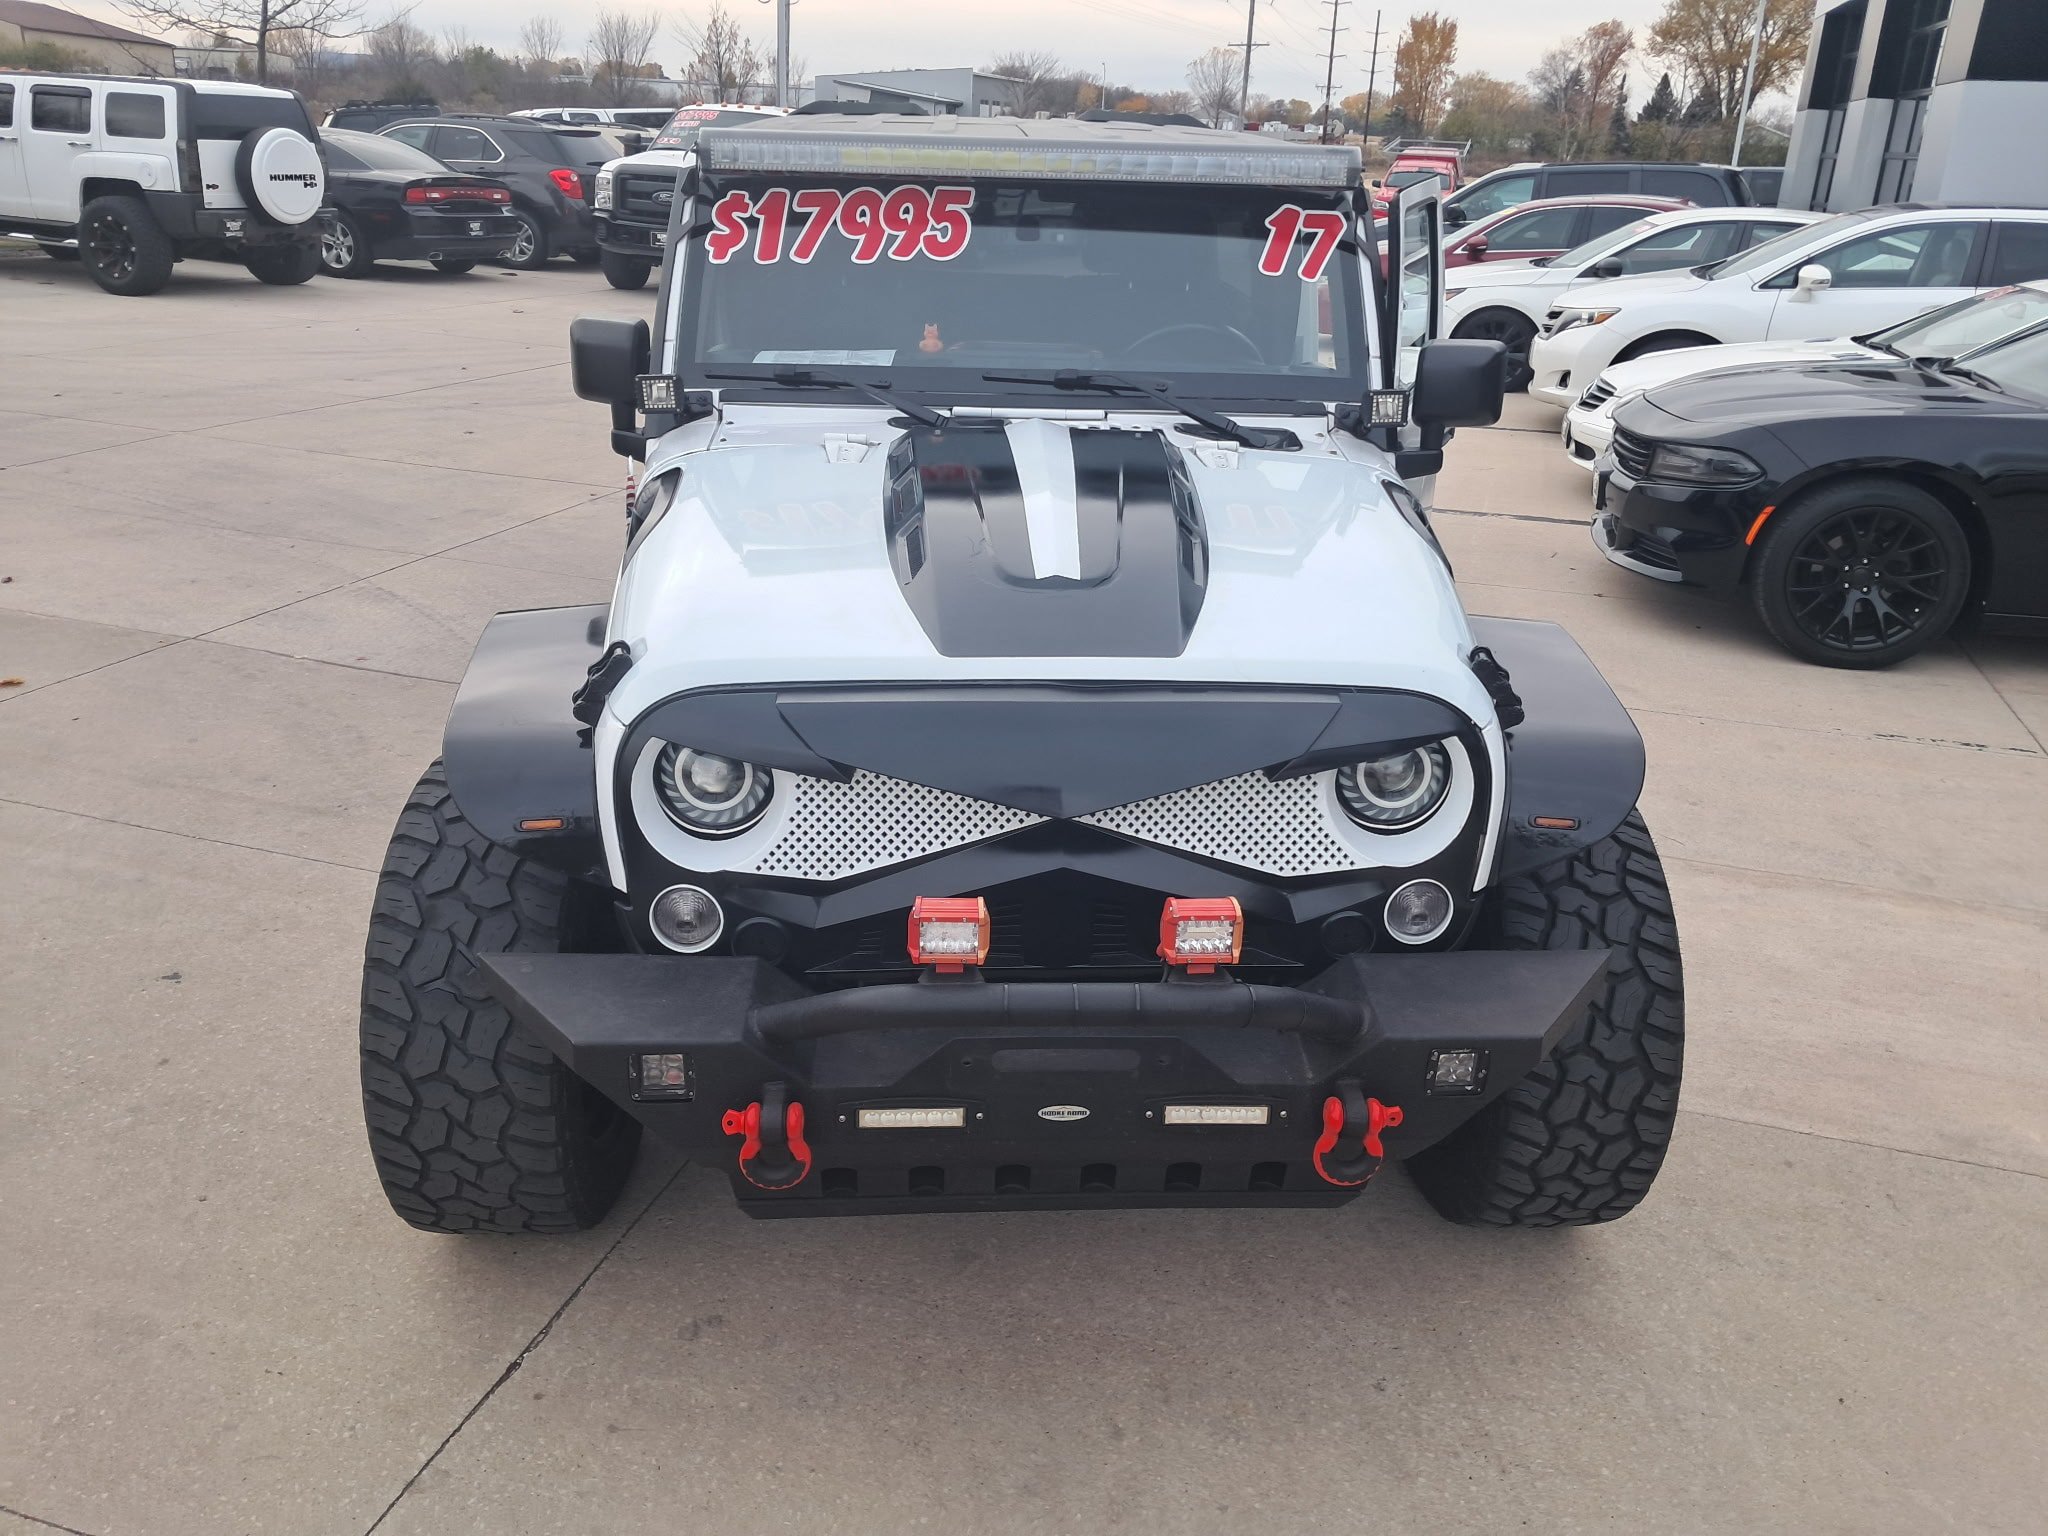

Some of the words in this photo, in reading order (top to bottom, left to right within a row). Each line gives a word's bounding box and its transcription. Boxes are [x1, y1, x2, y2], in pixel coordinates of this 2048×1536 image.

[269, 174, 317, 182] HUMMER
[705, 184, 975, 264] $17995
[1258, 203, 1347, 283] 17
